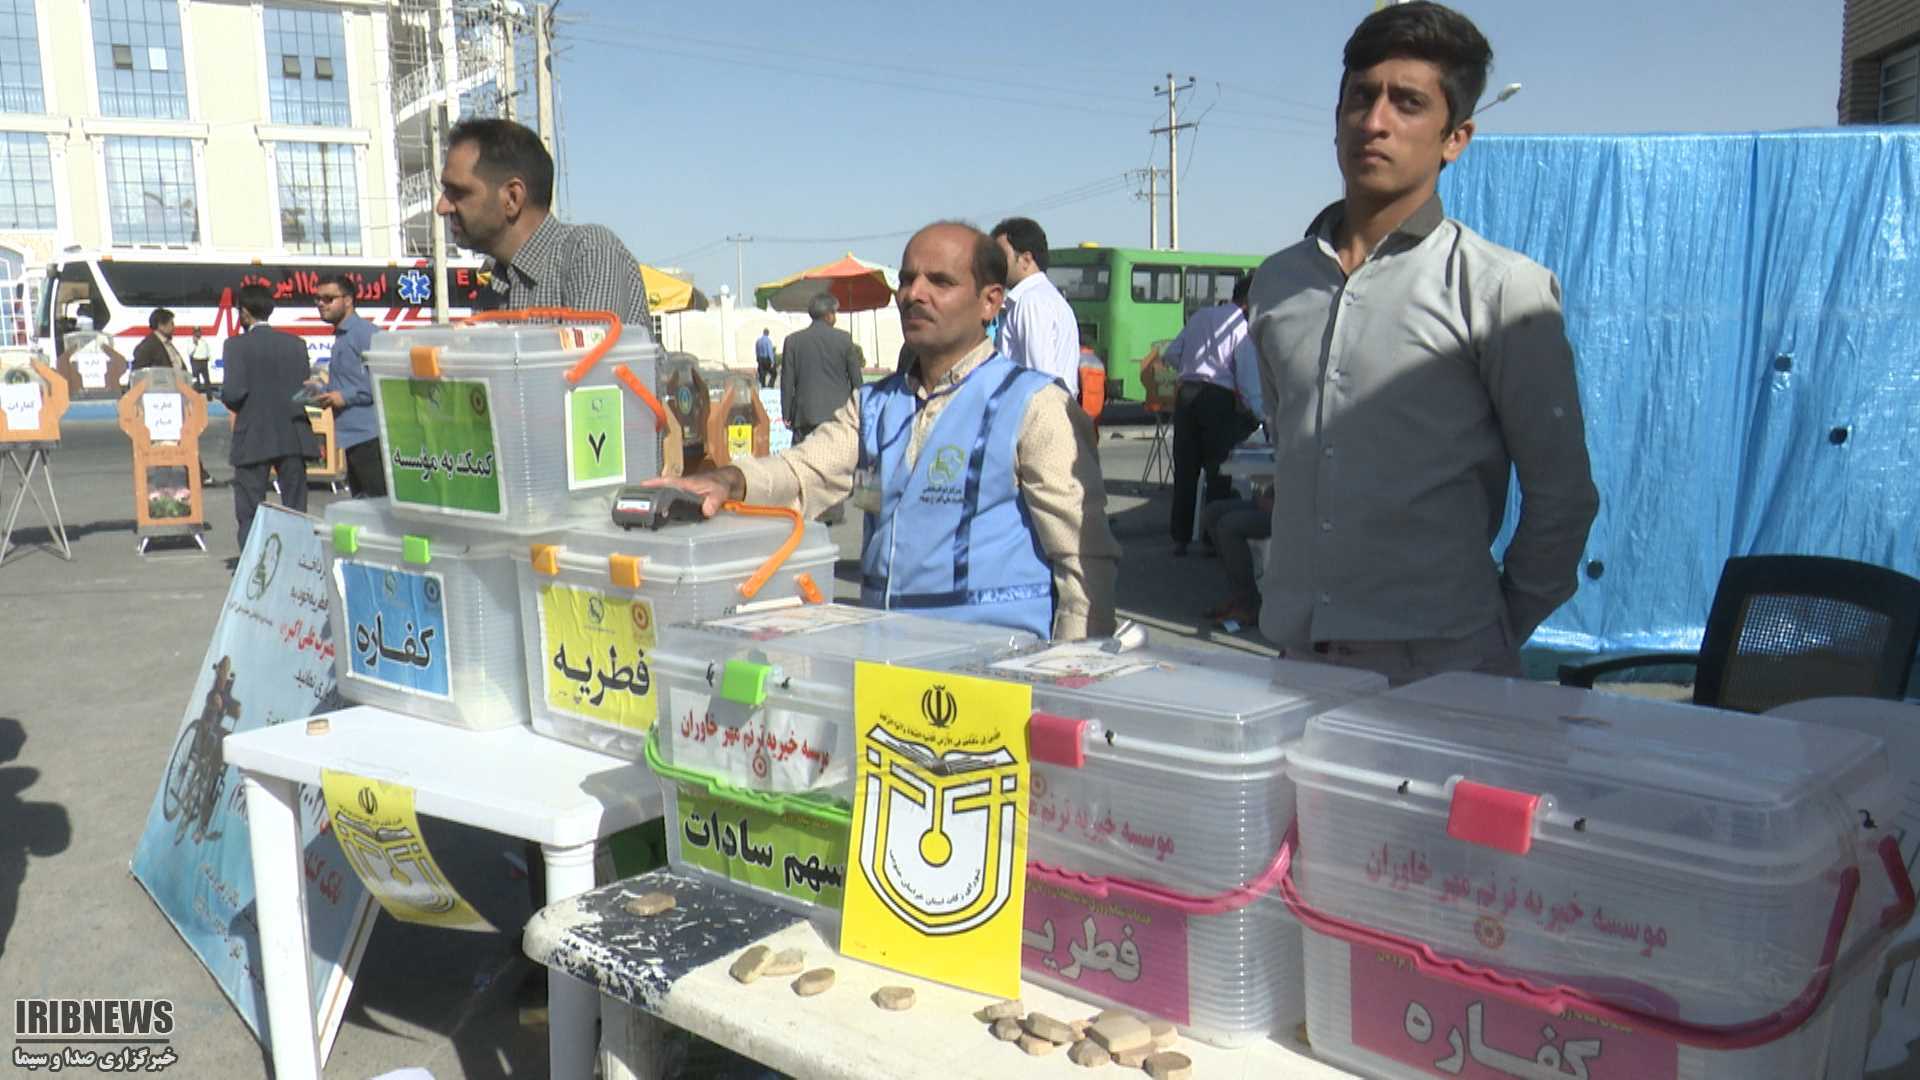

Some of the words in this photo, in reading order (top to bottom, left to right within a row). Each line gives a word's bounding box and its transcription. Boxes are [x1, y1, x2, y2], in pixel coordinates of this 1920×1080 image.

[440, 450, 455, 479] به
[456, 449, 494, 477] کمک
[588, 431, 607, 464] ۷
[356, 611, 434, 670] کفاره
[552, 643, 650, 706] فطریه
[680, 708, 719, 744] خاوران
[684, 810, 774, 869] سادات
[1364, 839, 1433, 891] خاوران
[1022, 915, 1142, 984] فطری
[1592, 905, 1668, 957] موسسه
[1402, 1000, 1602, 1080] کفاره
